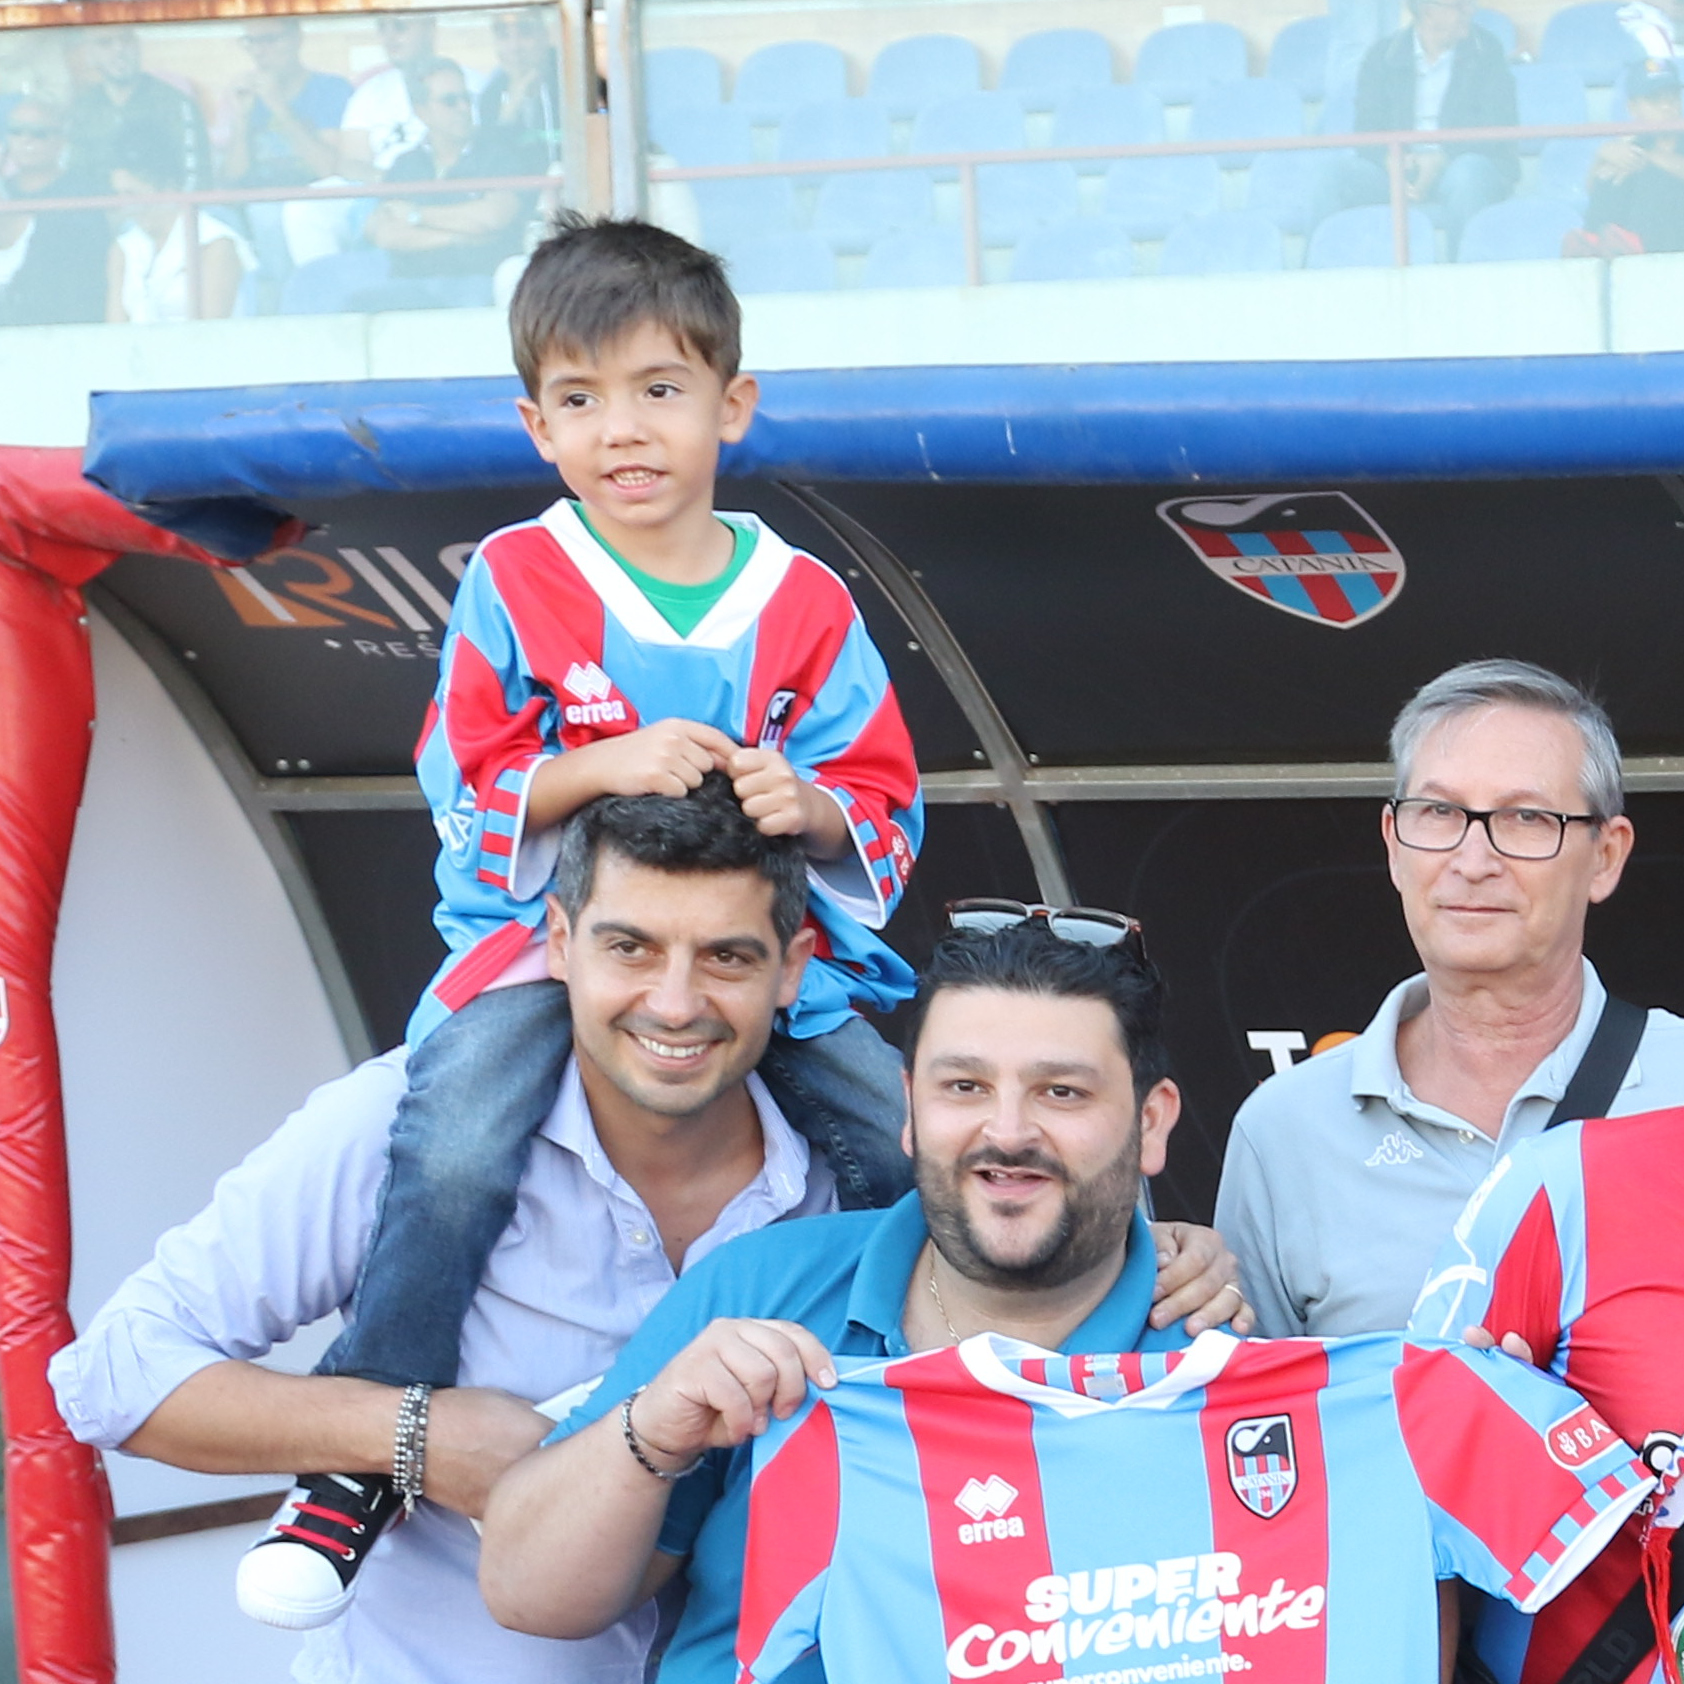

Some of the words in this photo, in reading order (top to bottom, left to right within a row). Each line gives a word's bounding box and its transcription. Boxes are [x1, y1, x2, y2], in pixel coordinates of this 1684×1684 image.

[1232, 555, 1389, 574] CATANIA
[1025, 1551, 1243, 1624] SUPER
[946, 1577, 1326, 1680] Conveniente
